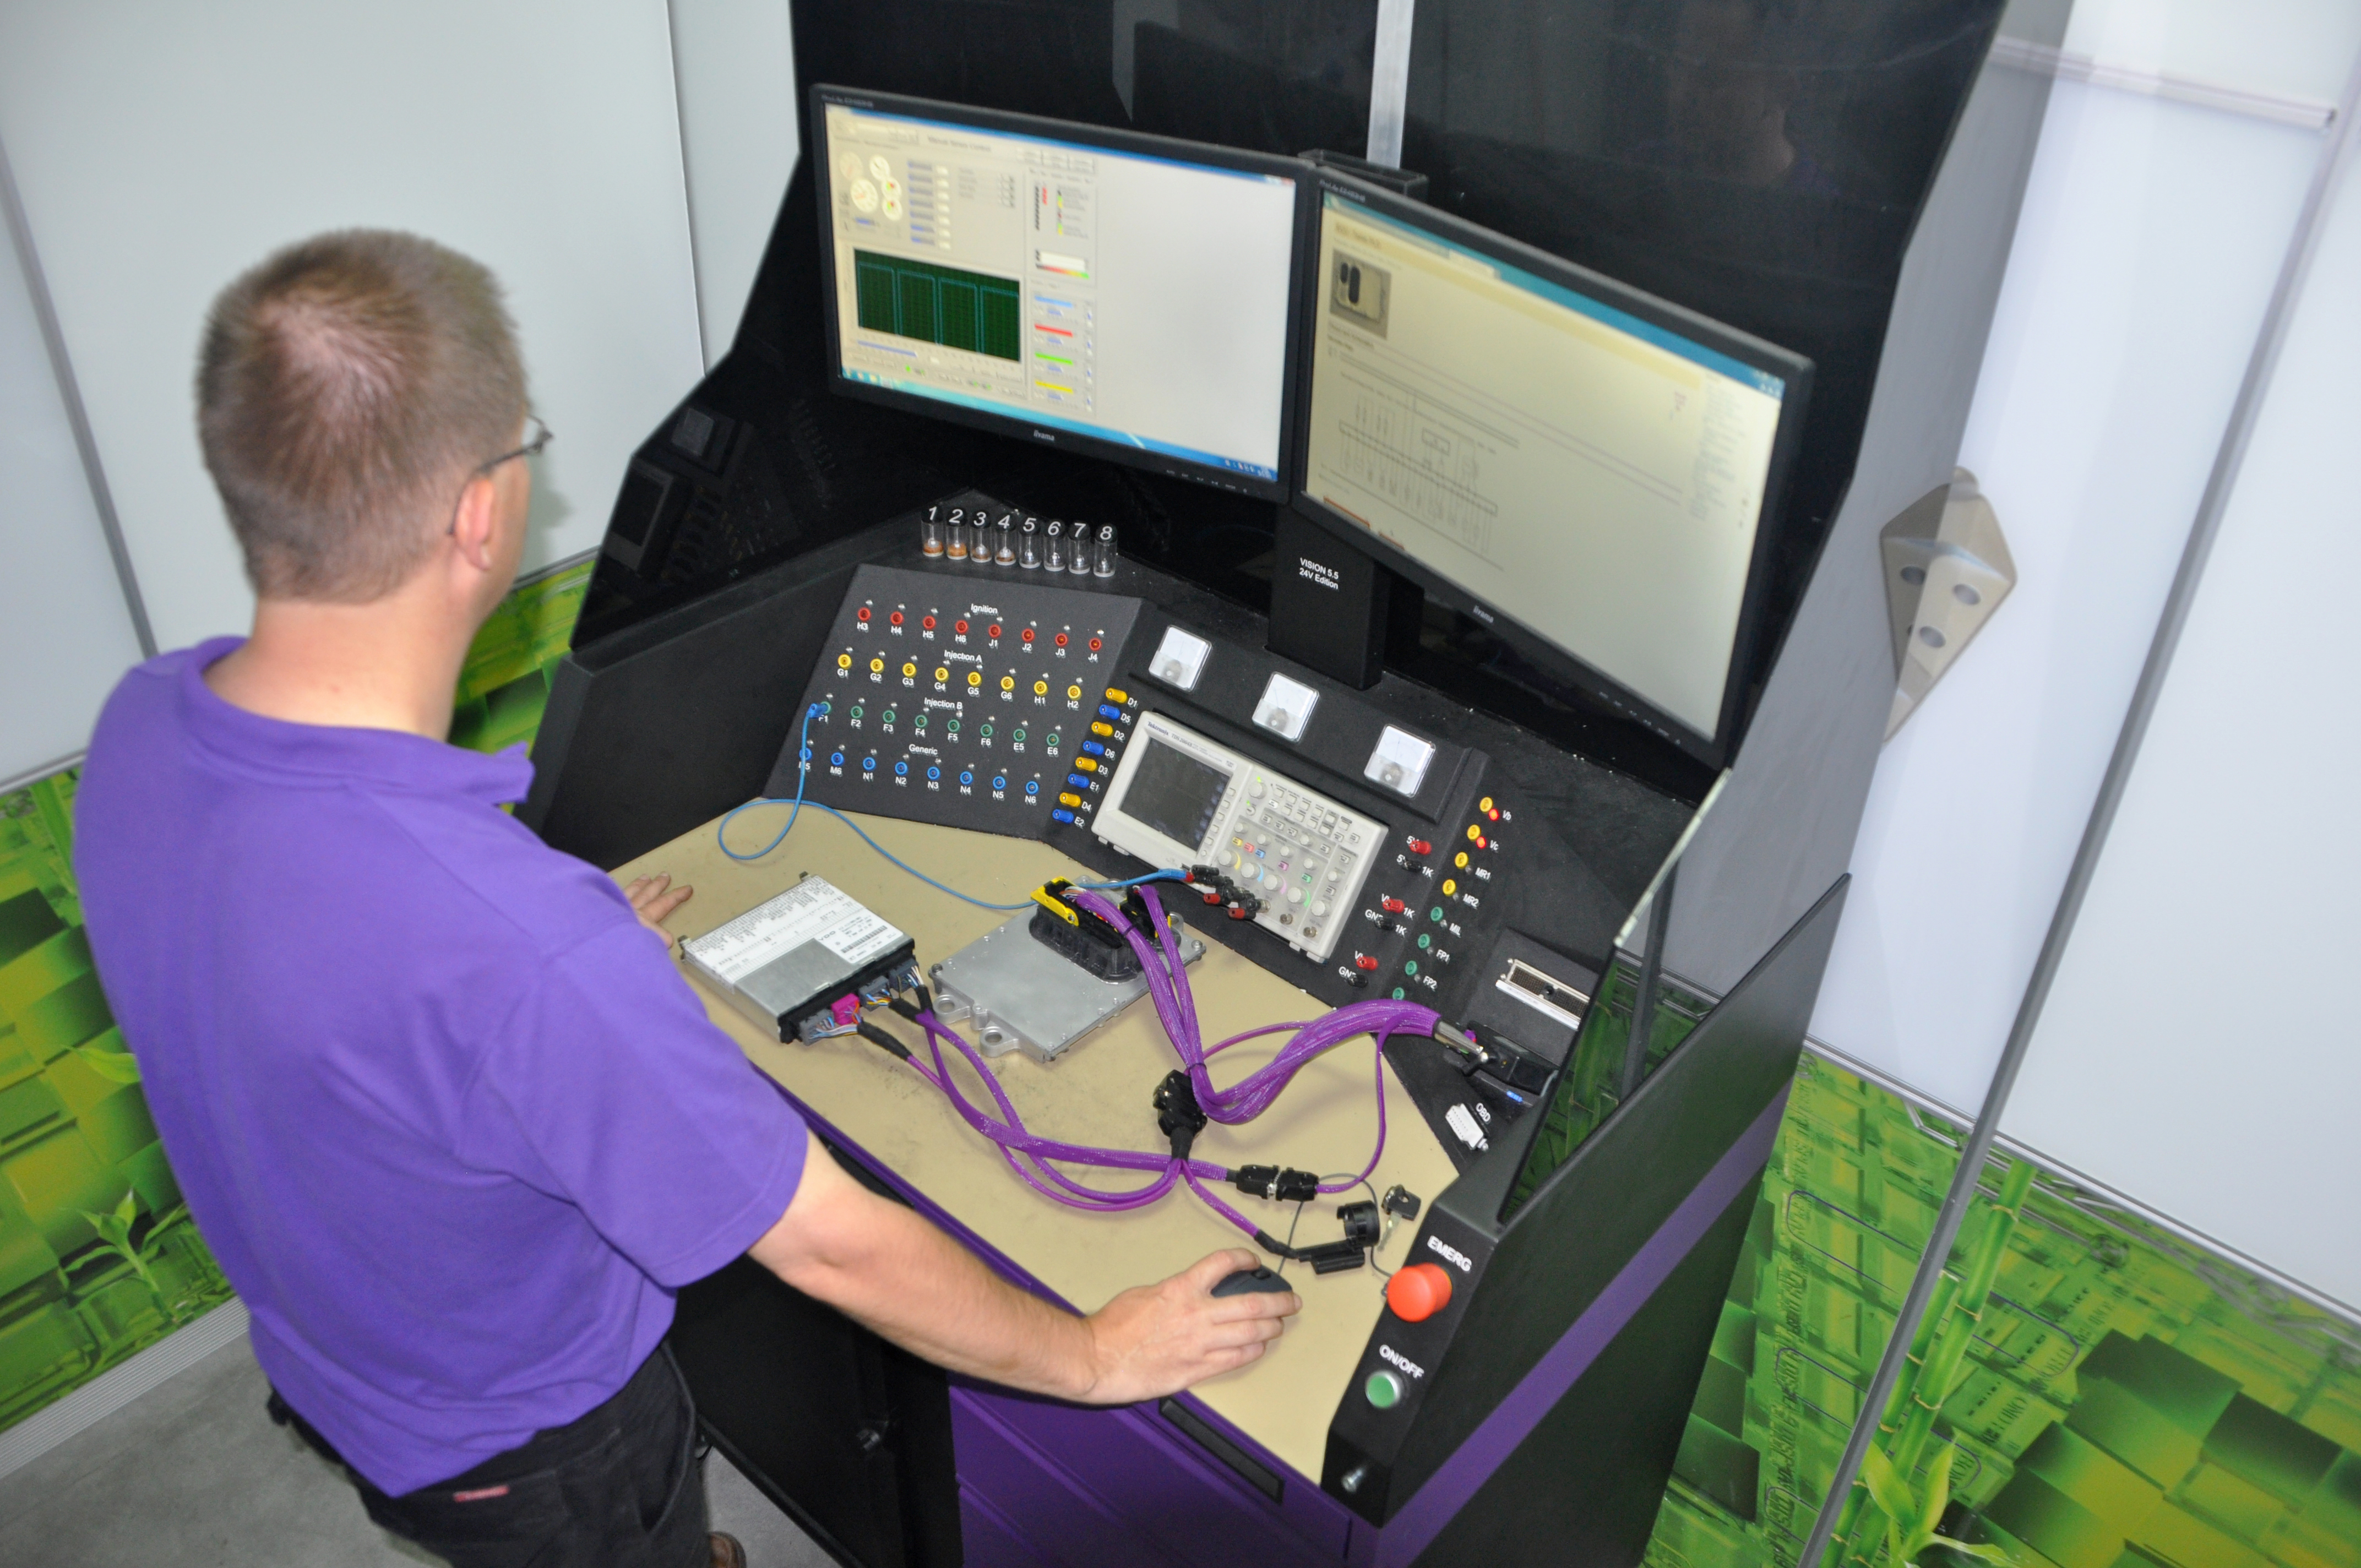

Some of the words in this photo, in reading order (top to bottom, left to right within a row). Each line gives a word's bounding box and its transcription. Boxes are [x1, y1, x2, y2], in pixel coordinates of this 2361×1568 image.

[929, 506, 937, 521] 1
[949, 509, 963, 524] 2
[973, 511, 987, 526] 3
[998, 515, 1010, 529] 4
[1022, 518, 1037, 532] 5
[1048, 521, 1061, 536] 6
[1074, 522, 1086, 537] 7
[1100, 526, 1113, 540] 8
[1300, 557, 1326, 574] VISION
[1328, 569, 1339, 580] 5.5
[1299, 568, 1314, 579] 24V
[1315, 574, 1339, 590] Edition
[971, 603, 998, 614] Ignition
[857, 622, 868, 630] H3
[890, 625, 902, 635] H4
[922, 630, 934, 639] H5
[955, 634, 966, 643] H6
[988, 639, 998, 647] J1
[1022, 643, 1032, 651] J2
[944, 650, 975, 661] Injection
[975, 654, 982, 663] A
[1055, 648, 1065, 656] J3
[1087, 652, 1098, 661] J4
[837, 668, 848, 677] G1
[870, 673, 882, 682] G2
[902, 677, 914, 686] G3
[934, 682, 946, 691] G4
[967, 687, 980, 695] G5
[1000, 691, 1012, 700] G6
[924, 697, 955, 709] Injection
[956, 701, 962, 710] B
[1034, 696, 1045, 704] H1
[1067, 700, 1079, 709] H2
[1127, 697, 1138, 707] D1
[851, 718, 861, 727] F2
[1120, 712, 1131, 723] D5
[883, 723, 894, 732] F3
[915, 728, 926, 737] F4
[1147, 721, 1169, 736] Tektronix
[948, 733, 958, 741] F5
[1114, 730, 1125, 741] D2
[981, 738, 991, 746] F6
[1013, 742, 1024, 750] E5
[909, 744, 938, 755] Generic
[1047, 747, 1058, 755] E6
[1105, 748, 1116, 759] D6
[830, 766, 842, 775] M6
[1098, 765, 1108, 775] D3
[863, 772, 873, 780] N1
[895, 776, 907, 785] N2
[927, 781, 939, 790] N3
[960, 785, 971, 794] N4
[1090, 781, 1100, 791] E1
[992, 790, 1004, 799] N5
[1025, 795, 1036, 804] N6
[1081, 801, 1092, 812] D4
[1503, 810, 1511, 821] Vb
[1074, 816, 1085, 827] E2
[1489, 840, 1499, 851] Vc
[1422, 866, 1434, 878] 1K
[1475, 867, 1491, 880] MR1
[1462, 894, 1479, 907] MR2
[1403, 907, 1415, 919] 1K
[1395, 924, 1407, 936] 1K
[1449, 923, 1461, 936] MIL
[818, 930, 836, 941] VDO
[1436, 949, 1450, 962] FP1
[1423, 976, 1437, 989] FP2
[1476, 1103, 1490, 1122] OBD
[1427, 1235, 1472, 1272] EMERG
[1379, 1344, 1424, 1378] ON/OFF
